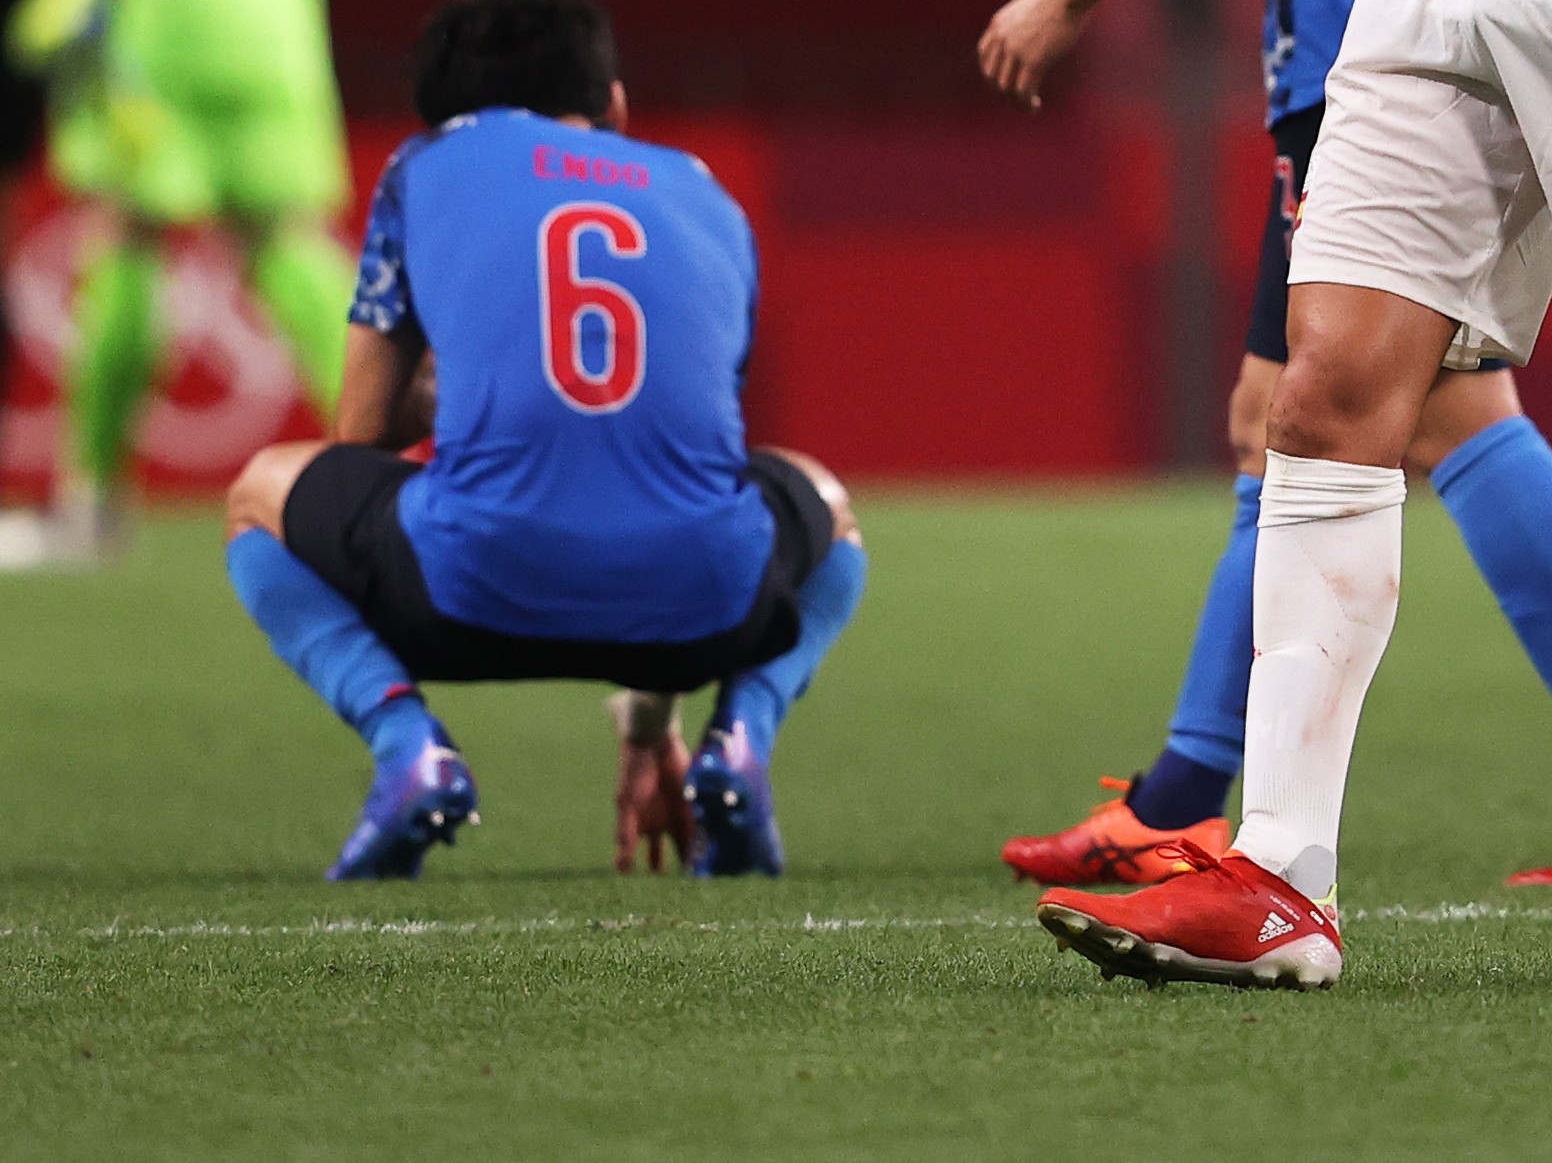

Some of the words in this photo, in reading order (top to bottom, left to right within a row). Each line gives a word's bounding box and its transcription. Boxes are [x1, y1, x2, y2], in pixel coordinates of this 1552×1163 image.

[533, 144, 650, 189] ENDO
[537, 200, 648, 415] 6
[1257, 923, 1294, 942] adidas
